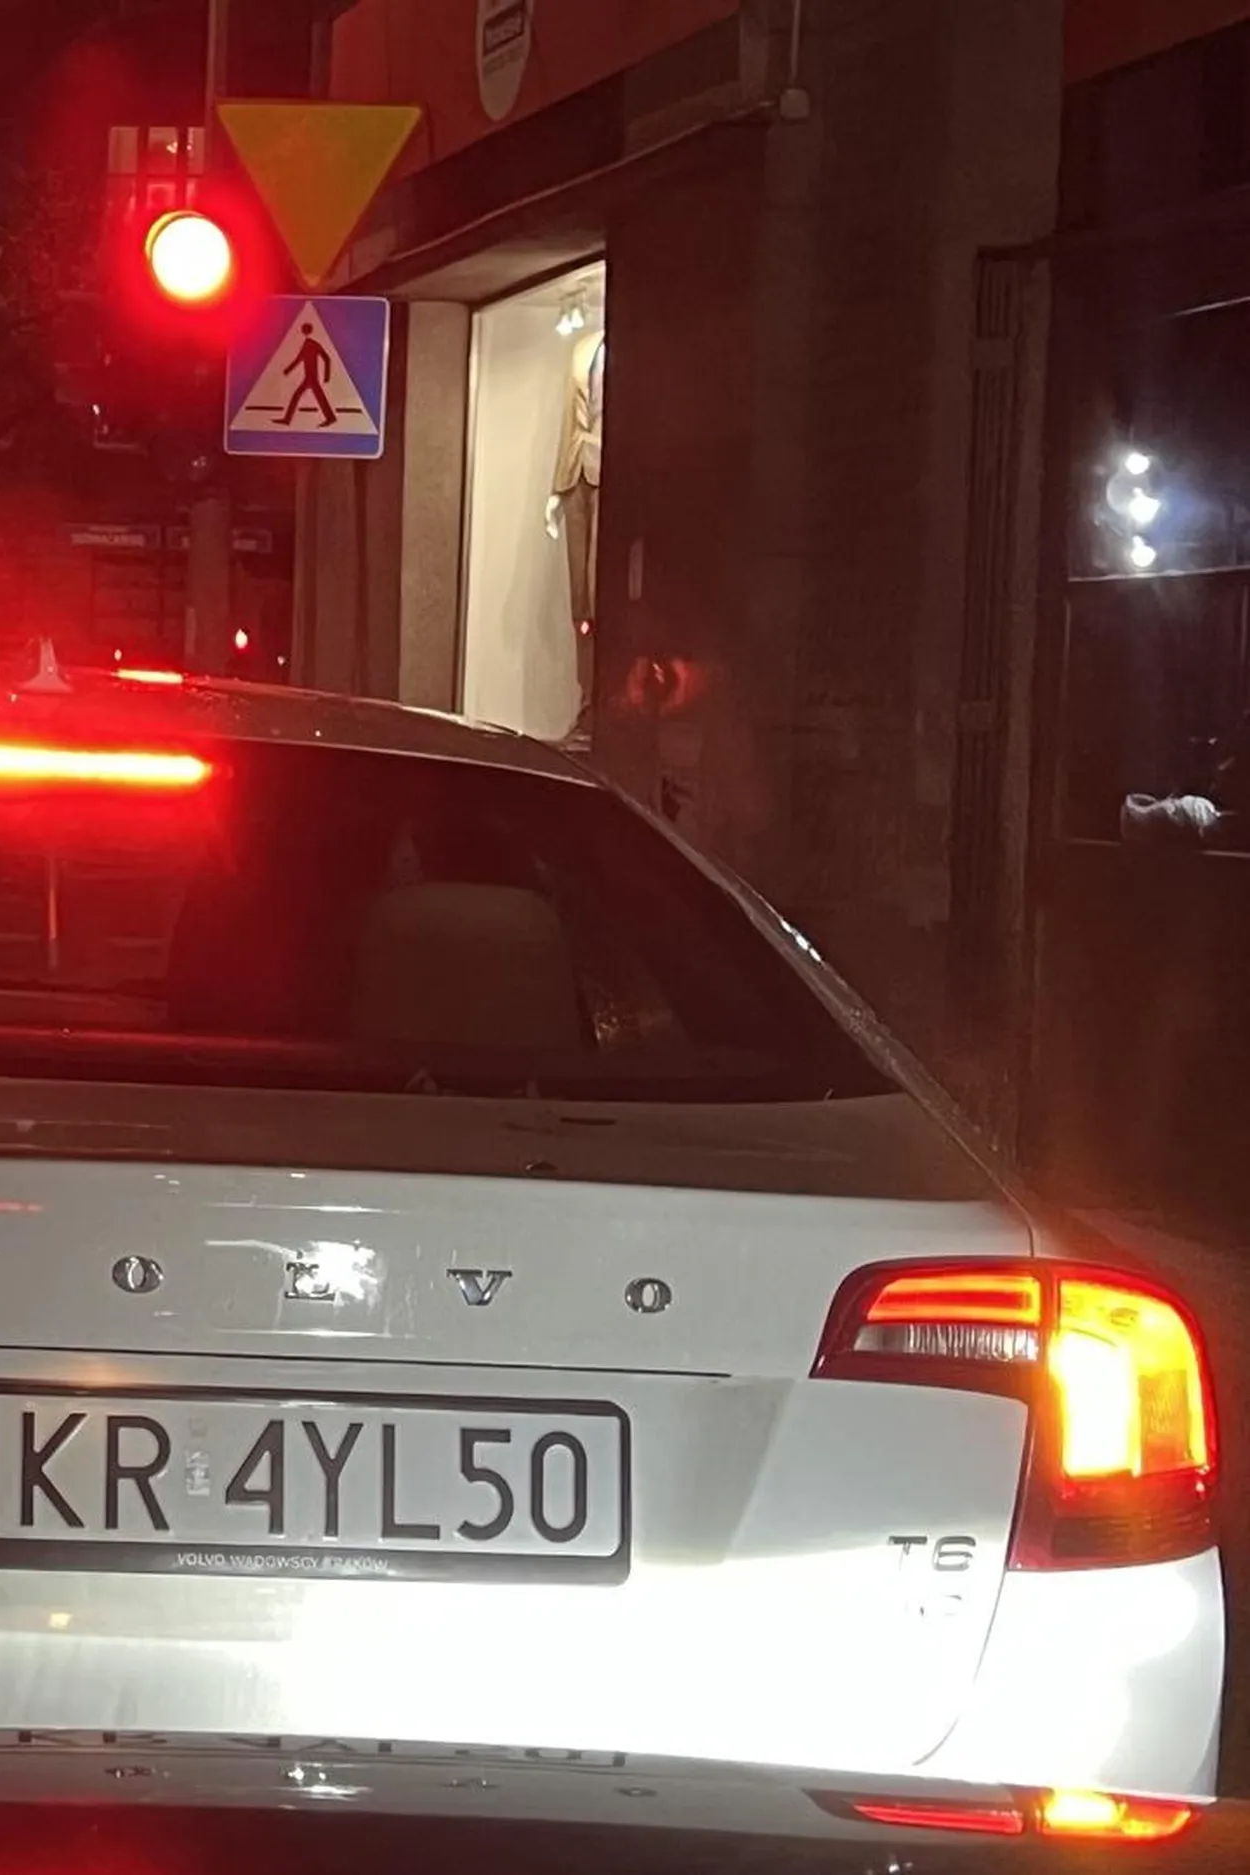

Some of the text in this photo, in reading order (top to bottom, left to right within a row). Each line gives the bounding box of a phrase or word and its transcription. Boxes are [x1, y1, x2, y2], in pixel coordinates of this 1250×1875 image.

[19, 1411, 590, 1544] KR 4YL50
[176, 1552, 226, 1568] VOLVO
[887, 1535, 976, 1572] T6
